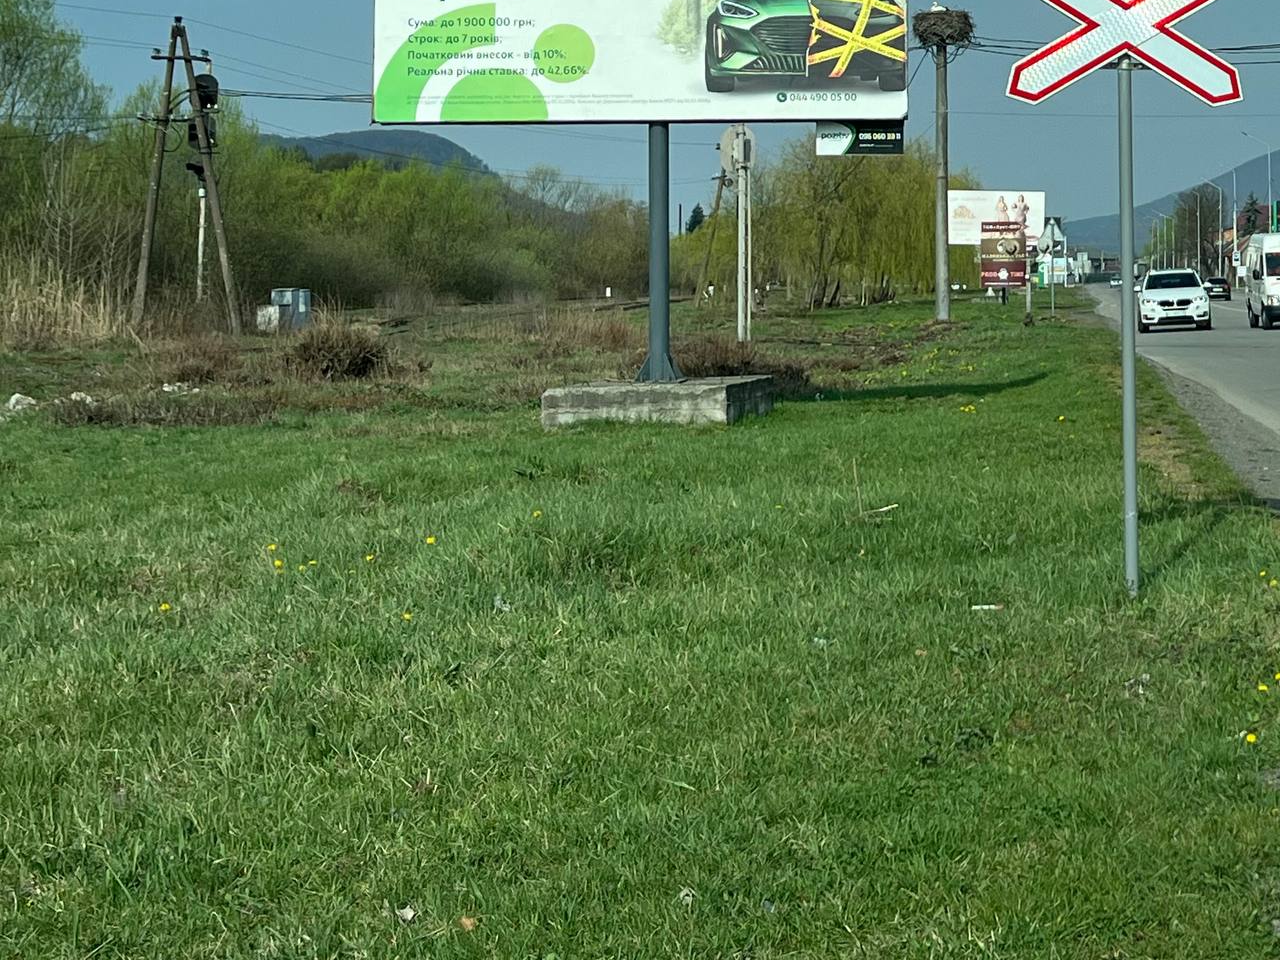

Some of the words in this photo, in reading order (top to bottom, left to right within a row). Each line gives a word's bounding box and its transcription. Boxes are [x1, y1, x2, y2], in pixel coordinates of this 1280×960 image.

[408, 18, 438, 30] Сума:
[440, 18, 454, 28] до
[489, 17, 511, 27] 000
[408, 34, 443, 45] Строк:
[445, 35, 459, 45] до
[462, 34, 468, 43] 7
[476, 51, 514, 59] внесок
[523, 50, 540, 60] від
[407, 66, 453, 76] Реальна
[456, 66, 486, 77] річна
[489, 67, 528, 76] ставка:
[531, 67, 545, 77] до
[790, 93, 808, 101] 044
[810, 93, 828, 101] 490
[830, 93, 842, 101] 05
[844, 93, 857, 101] 00
